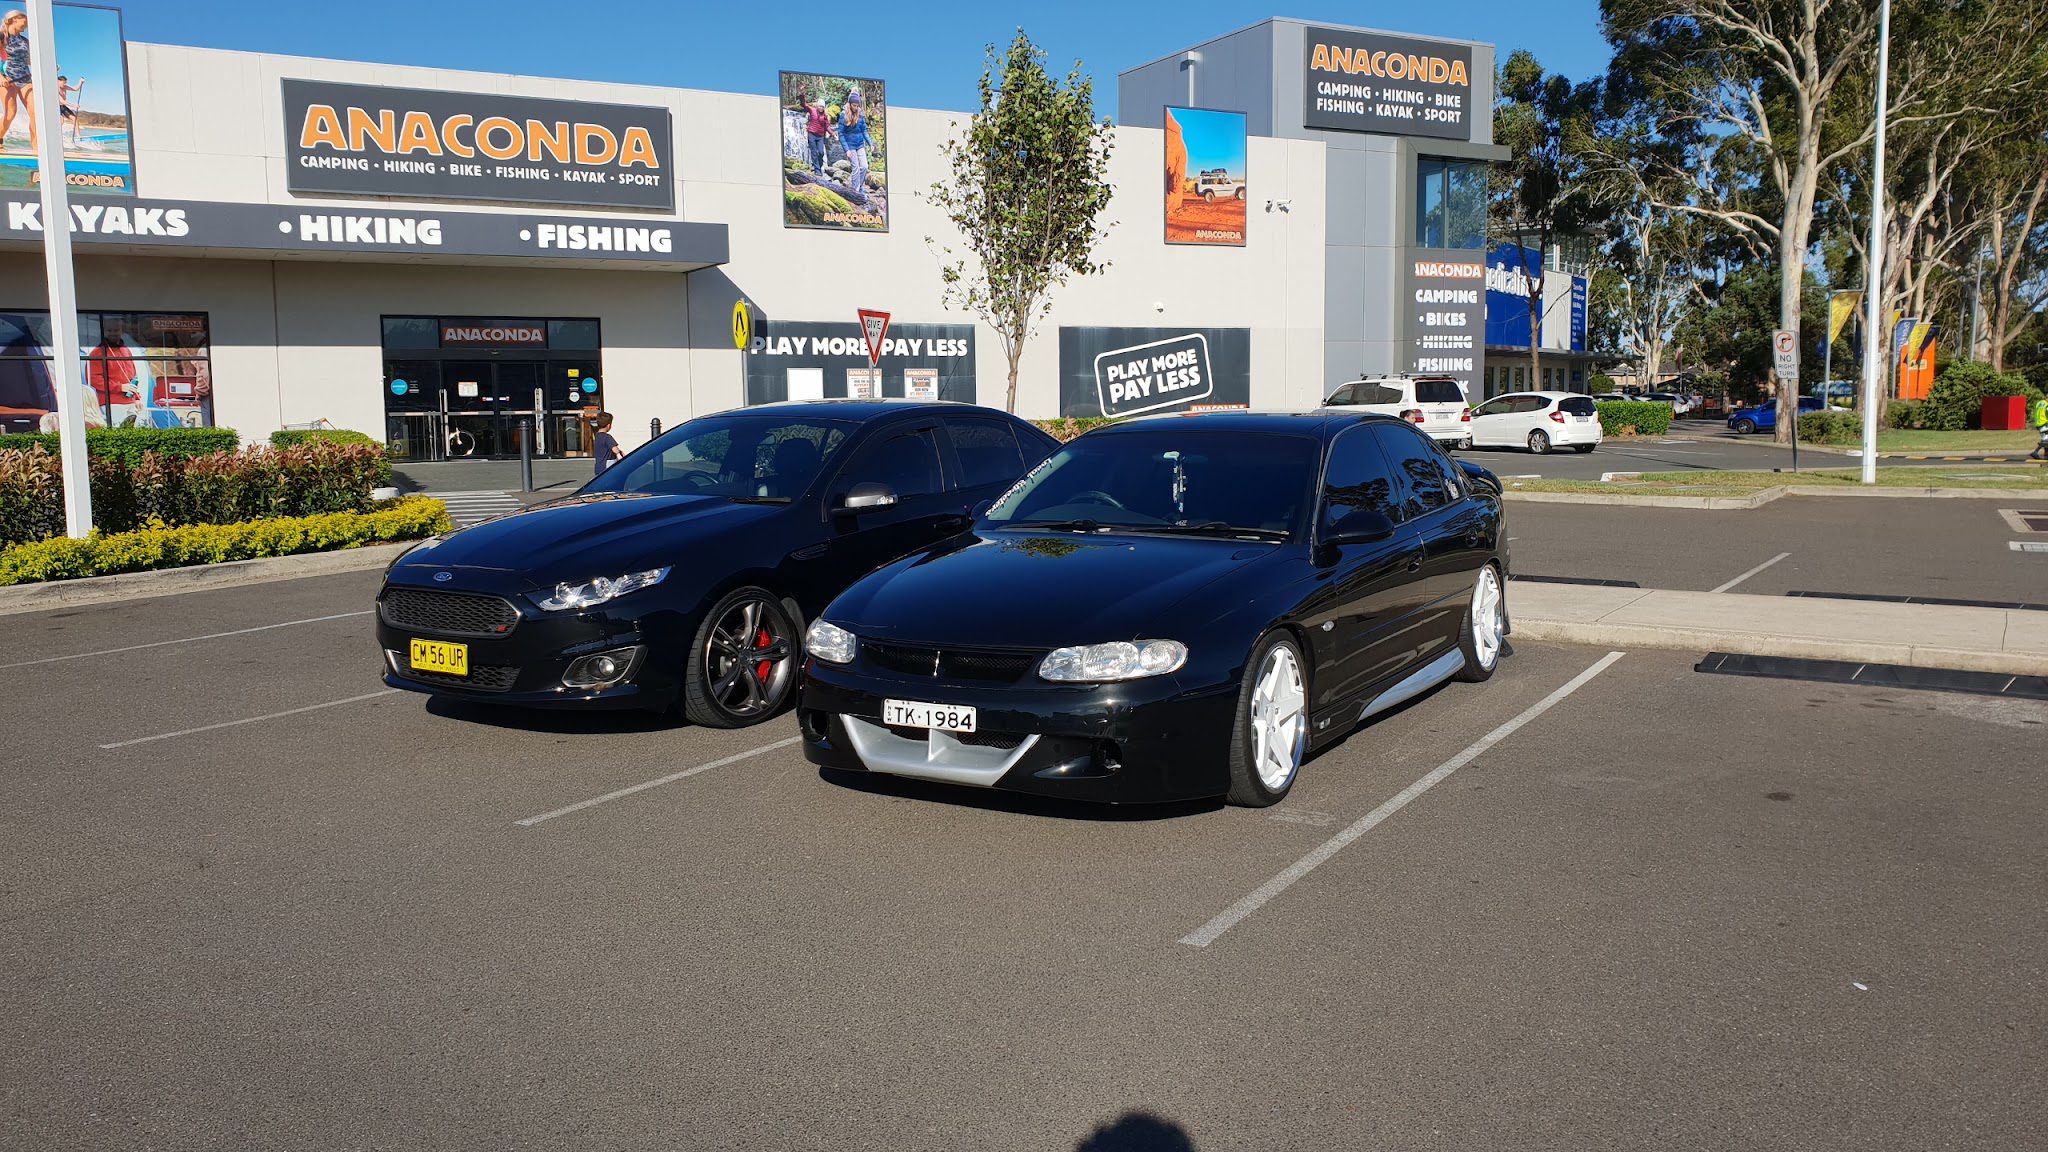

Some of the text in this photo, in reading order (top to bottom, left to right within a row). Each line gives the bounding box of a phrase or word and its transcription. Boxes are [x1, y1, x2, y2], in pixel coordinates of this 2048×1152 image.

[1311, 44, 1468, 86] ANACONDA
[1317, 81, 1461, 108] CAMPING HIKING BIKE
[1317, 98, 1462, 123] FISHING KAYAK SPORT
[300, 104, 660, 169] ANACONDA
[300, 155, 660, 187] CAMPING HIKING BIKE FISHING KAYAK SPORT
[8, 201, 189, 237] KYAKS
[300, 214, 442, 246] HIKING
[823, 212, 883, 225] ANACONDA
[537, 223, 673, 253] FISHING
[1195, 229, 1242, 240] ANACONDA
[1415, 288, 1478, 304] CAMPING
[866, 319, 881, 329] GIVE
[1426, 312, 1467, 326] BIKES
[444, 327, 543, 342] ANACONDA
[1423, 335, 1473, 348] HIKING
[751, 336, 967, 357] PLAY MORE PAY LESS
[1779, 354, 1792, 362] NO
[1107, 348, 1198, 382] PLAY MORE
[1418, 357, 1473, 371] FISHING
[1109, 365, 1201, 404] PAY LESS
[430, 645, 445, 665] 56
[449, 647, 465, 668] UR
